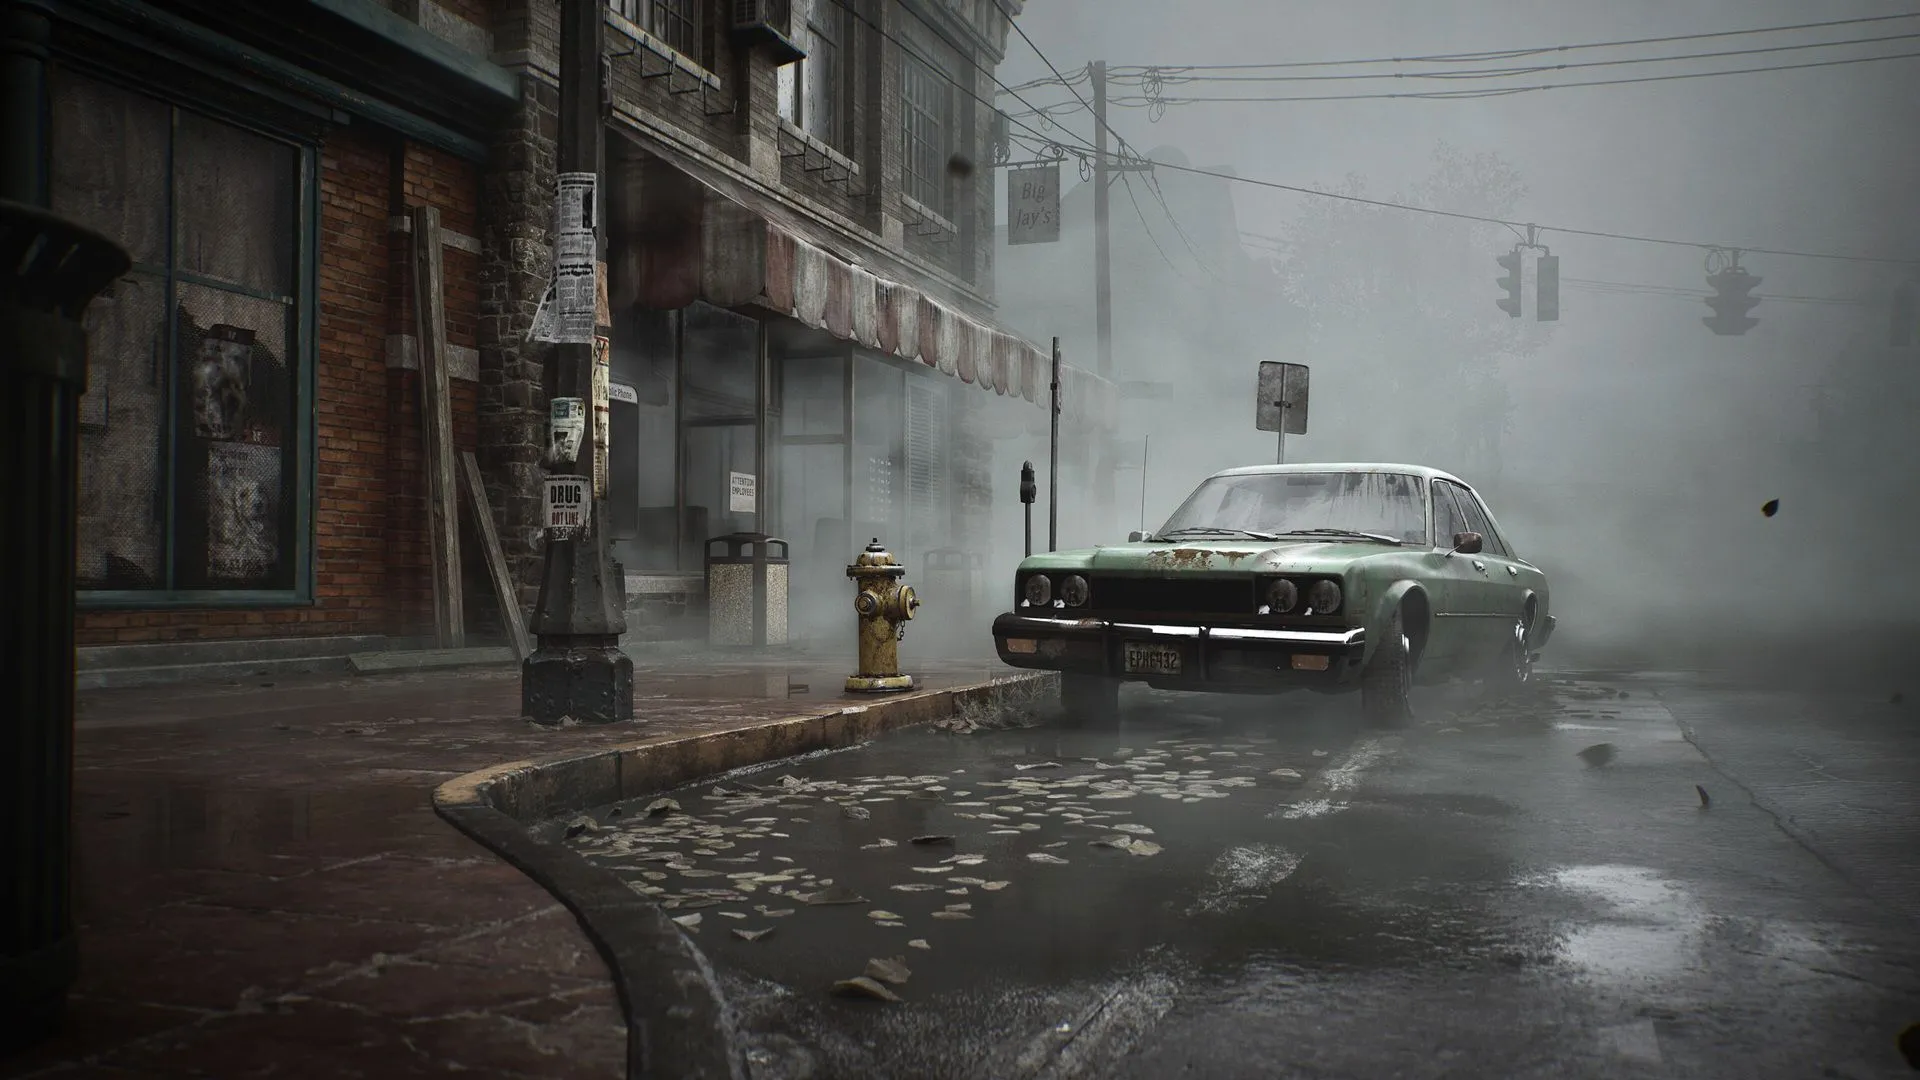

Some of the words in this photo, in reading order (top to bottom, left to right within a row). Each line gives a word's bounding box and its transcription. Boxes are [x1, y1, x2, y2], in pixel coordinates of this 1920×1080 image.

[1021, 182, 1046, 204] Big
[1013, 206, 1052, 235] Jay's
[617, 387, 633, 400] Phone
[732, 476, 755, 487] ATTENTION
[550, 485, 581, 504] DRUG
[732, 486, 755, 497] EMPLOYEES
[564, 512, 579, 525] LINE
